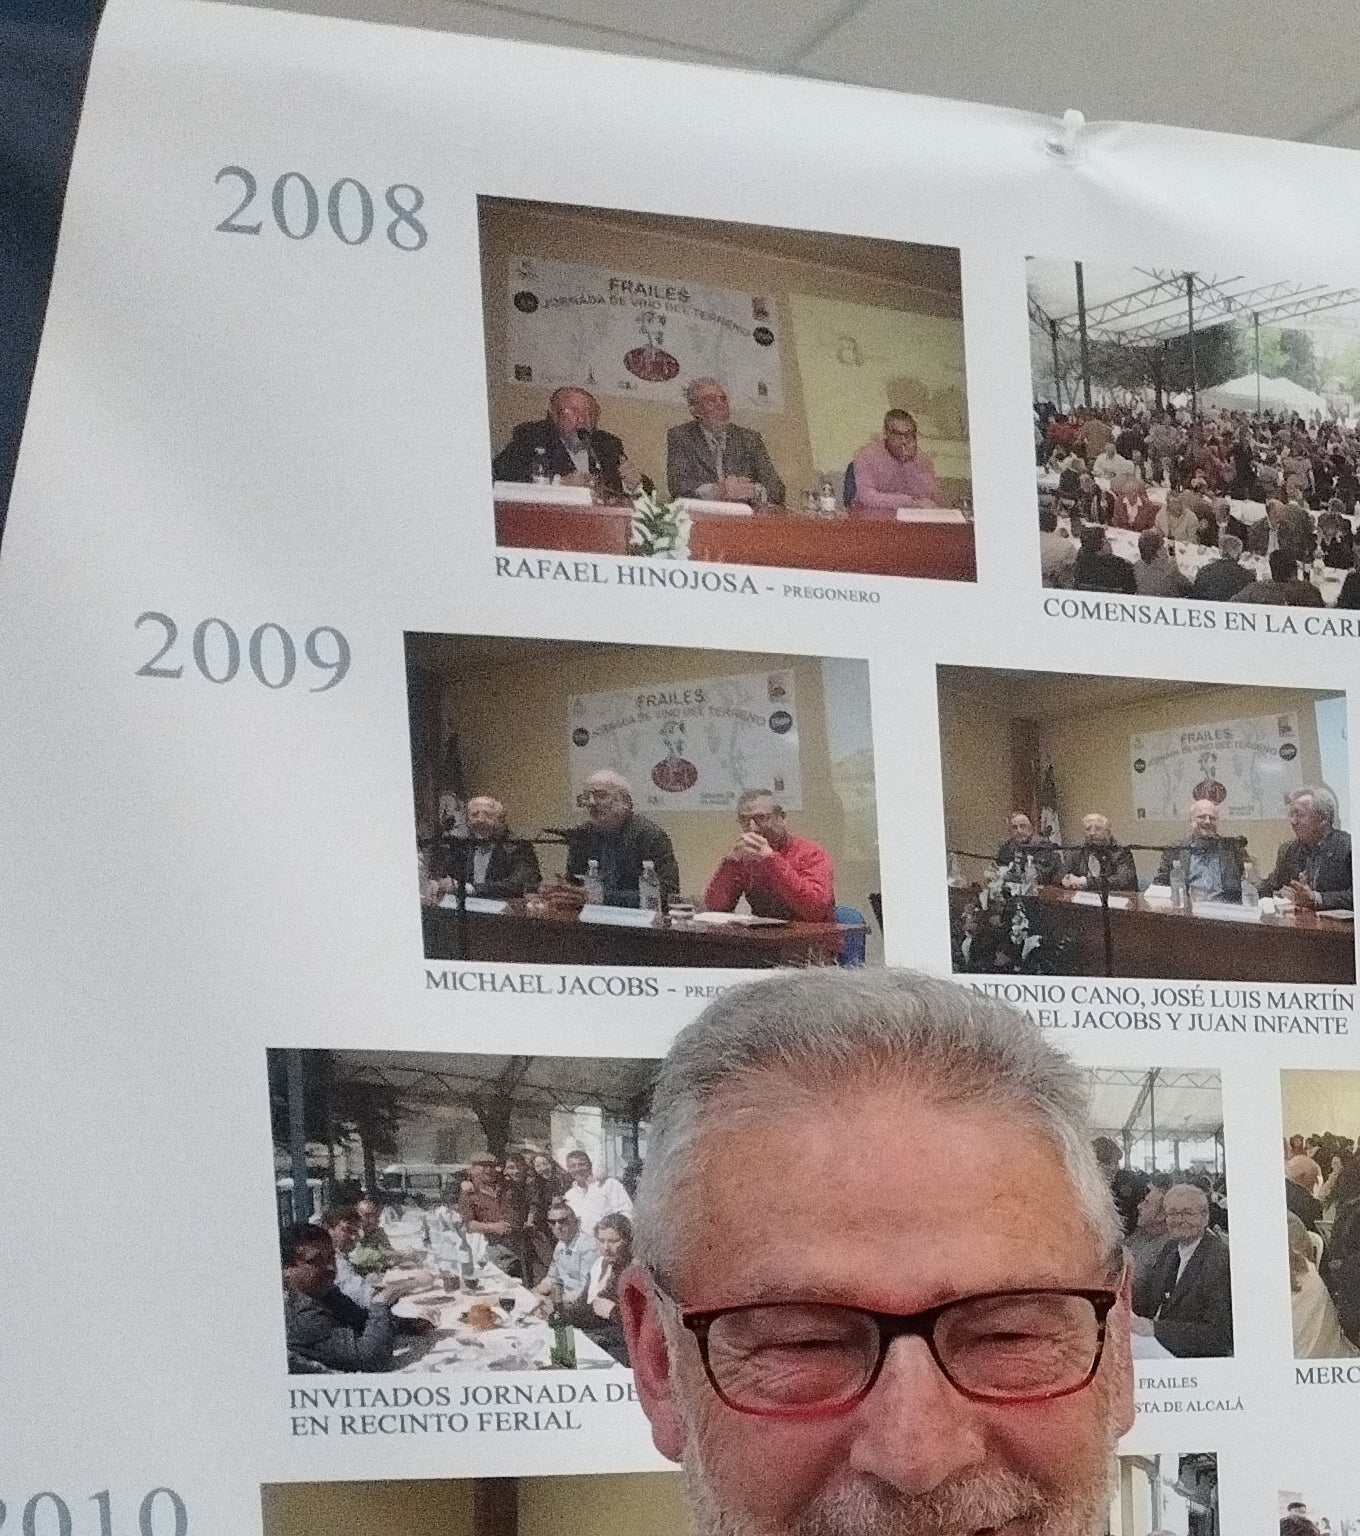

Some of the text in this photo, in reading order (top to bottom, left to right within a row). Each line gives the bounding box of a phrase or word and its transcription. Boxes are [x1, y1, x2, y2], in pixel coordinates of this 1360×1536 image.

[214, 166, 428, 250] 2008
[609, 277, 690, 302] FRAILES
[495, 556, 880, 604] RAFAEL HINOJOSA PREGONERO
[1043, 597, 1216, 630] COMENSALES
[1225, 612, 1256, 632] EN
[1266, 614, 1298, 634] LA
[134, 611, 351, 693] 2009
[425, 969, 552, 994] MICHAEL
[557, 975, 659, 996] JACOBS
[1071, 1011, 1161, 1030] JACOBS
[1165, 1012, 1183, 1030] Y
[1188, 1015, 1247, 1032] JUAN
[1254, 1016, 1348, 1035] INFANTE
[1139, 1377, 1198, 1389] FRAILES
[288, 1387, 451, 1409] INVITADOS
[460, 1384, 597, 1407] JORNADA
[1164, 1401, 1182, 1413] DE
[1186, 1397, 1243, 1412] ALCALÁ
[292, 1410, 582, 1435] EN RECINTO FERIAL
